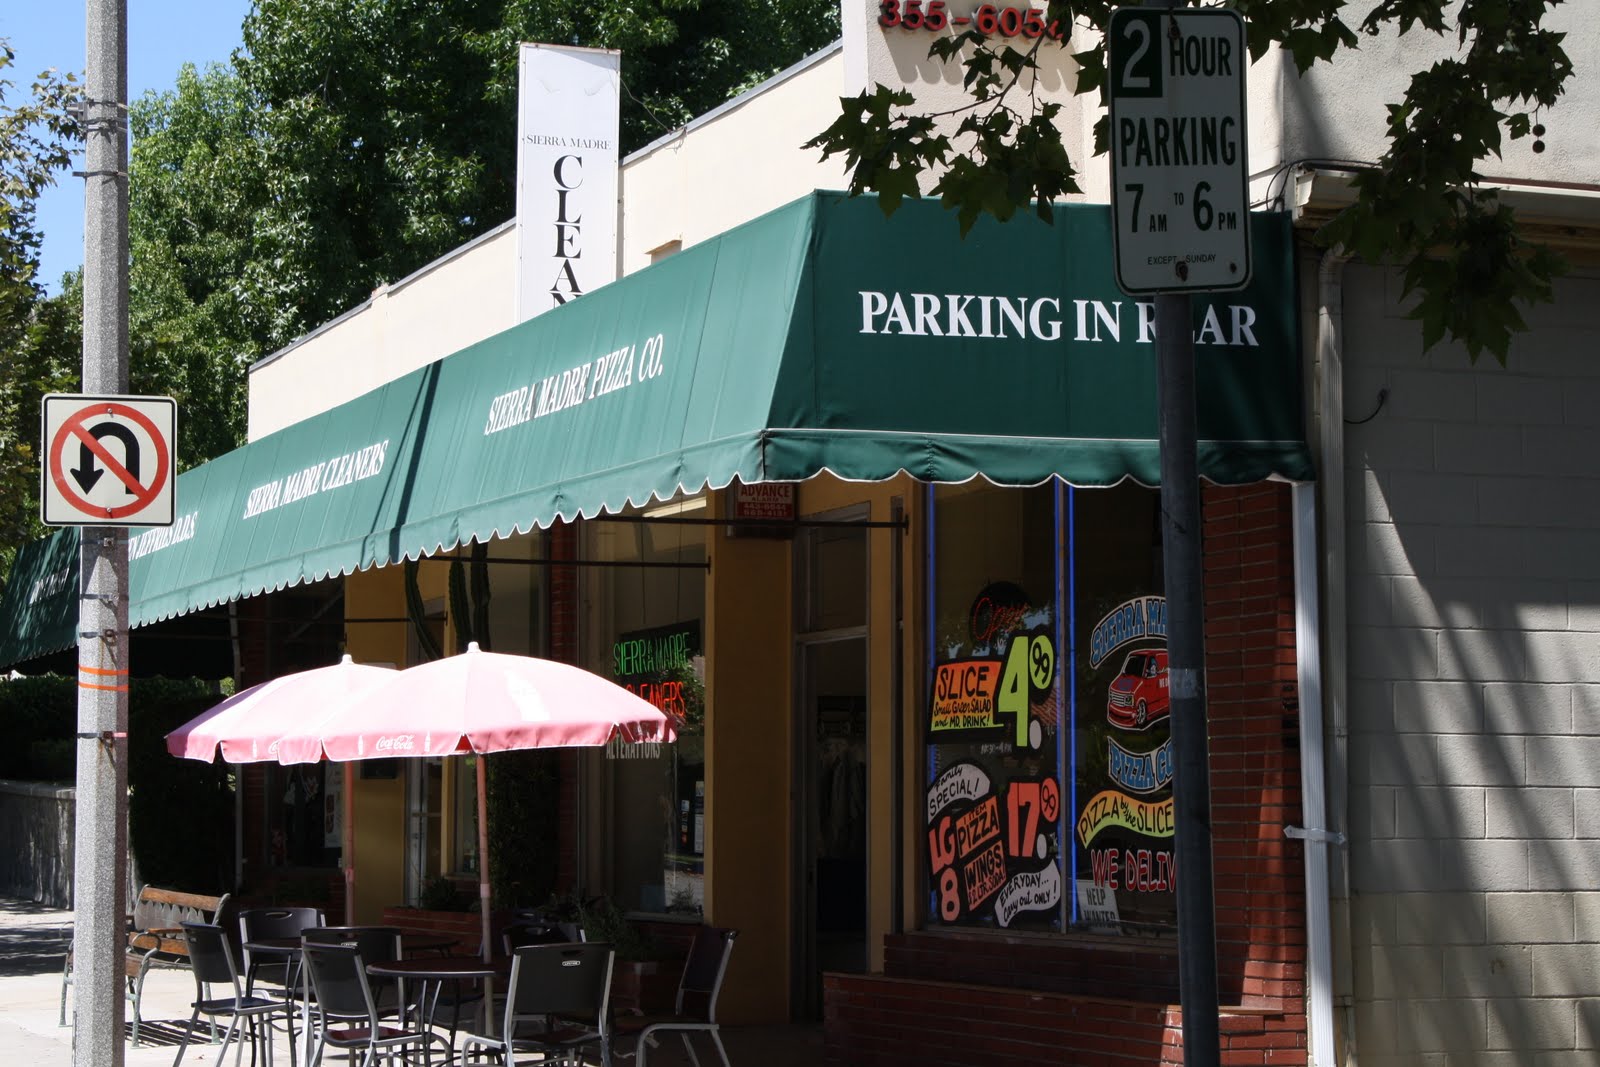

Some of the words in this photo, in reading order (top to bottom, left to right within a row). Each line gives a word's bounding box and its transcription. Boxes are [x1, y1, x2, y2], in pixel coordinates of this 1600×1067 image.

[1121, 18, 1151, 89] 2
[1170, 34, 1232, 77] HOUR
[526, 133, 567, 148] SIERRA
[570, 137, 612, 151] MADRE
[1120, 115, 1236, 168] PARKING
[1125, 183, 1144, 233] 7
[1149, 213, 1167, 233] AM
[1173, 192, 1184, 206] TO
[1193, 181, 1214, 232] 6
[1218, 212, 1237, 231] PM
[1147, 255, 1177, 265] EXCEPT
[1185, 253, 1216, 264] SUNDAY
[857, 290, 1063, 342] PARKING
[1072, 299, 1122, 343] IN
[1135, 301, 1260, 346] RAR
[484, 383, 536, 436] SIERRA
[533, 362, 592, 419] MADRE
[588, 343, 636, 400] PIZZA
[638, 333, 664, 383] CO.
[243, 478, 283, 520] SIERRA
[279, 462, 326, 507] MADRE
[321, 439, 390, 492] CLEANERS
[740, 484, 791, 498] ADVANCE
[613, 639, 656, 676] SIERRA
[653, 632, 692, 674] MADRE
[1092, 601, 1145, 665] SIERRA
[962, 713, 991, 728] DRINK!
[970, 698, 992, 713] SALAD
[1110, 742, 1156, 788] PIZZA
[957, 804, 999, 854] PIZZA
[1080, 796, 1120, 843] PIZZA
[1136, 802, 1174, 834] SLICE
[965, 843, 1004, 890] WINGS
[1090, 847, 1120, 891] WE
[940, 867, 961, 921] 8
[1019, 890, 1033, 906] out
[1086, 887, 1106, 906] HELP
